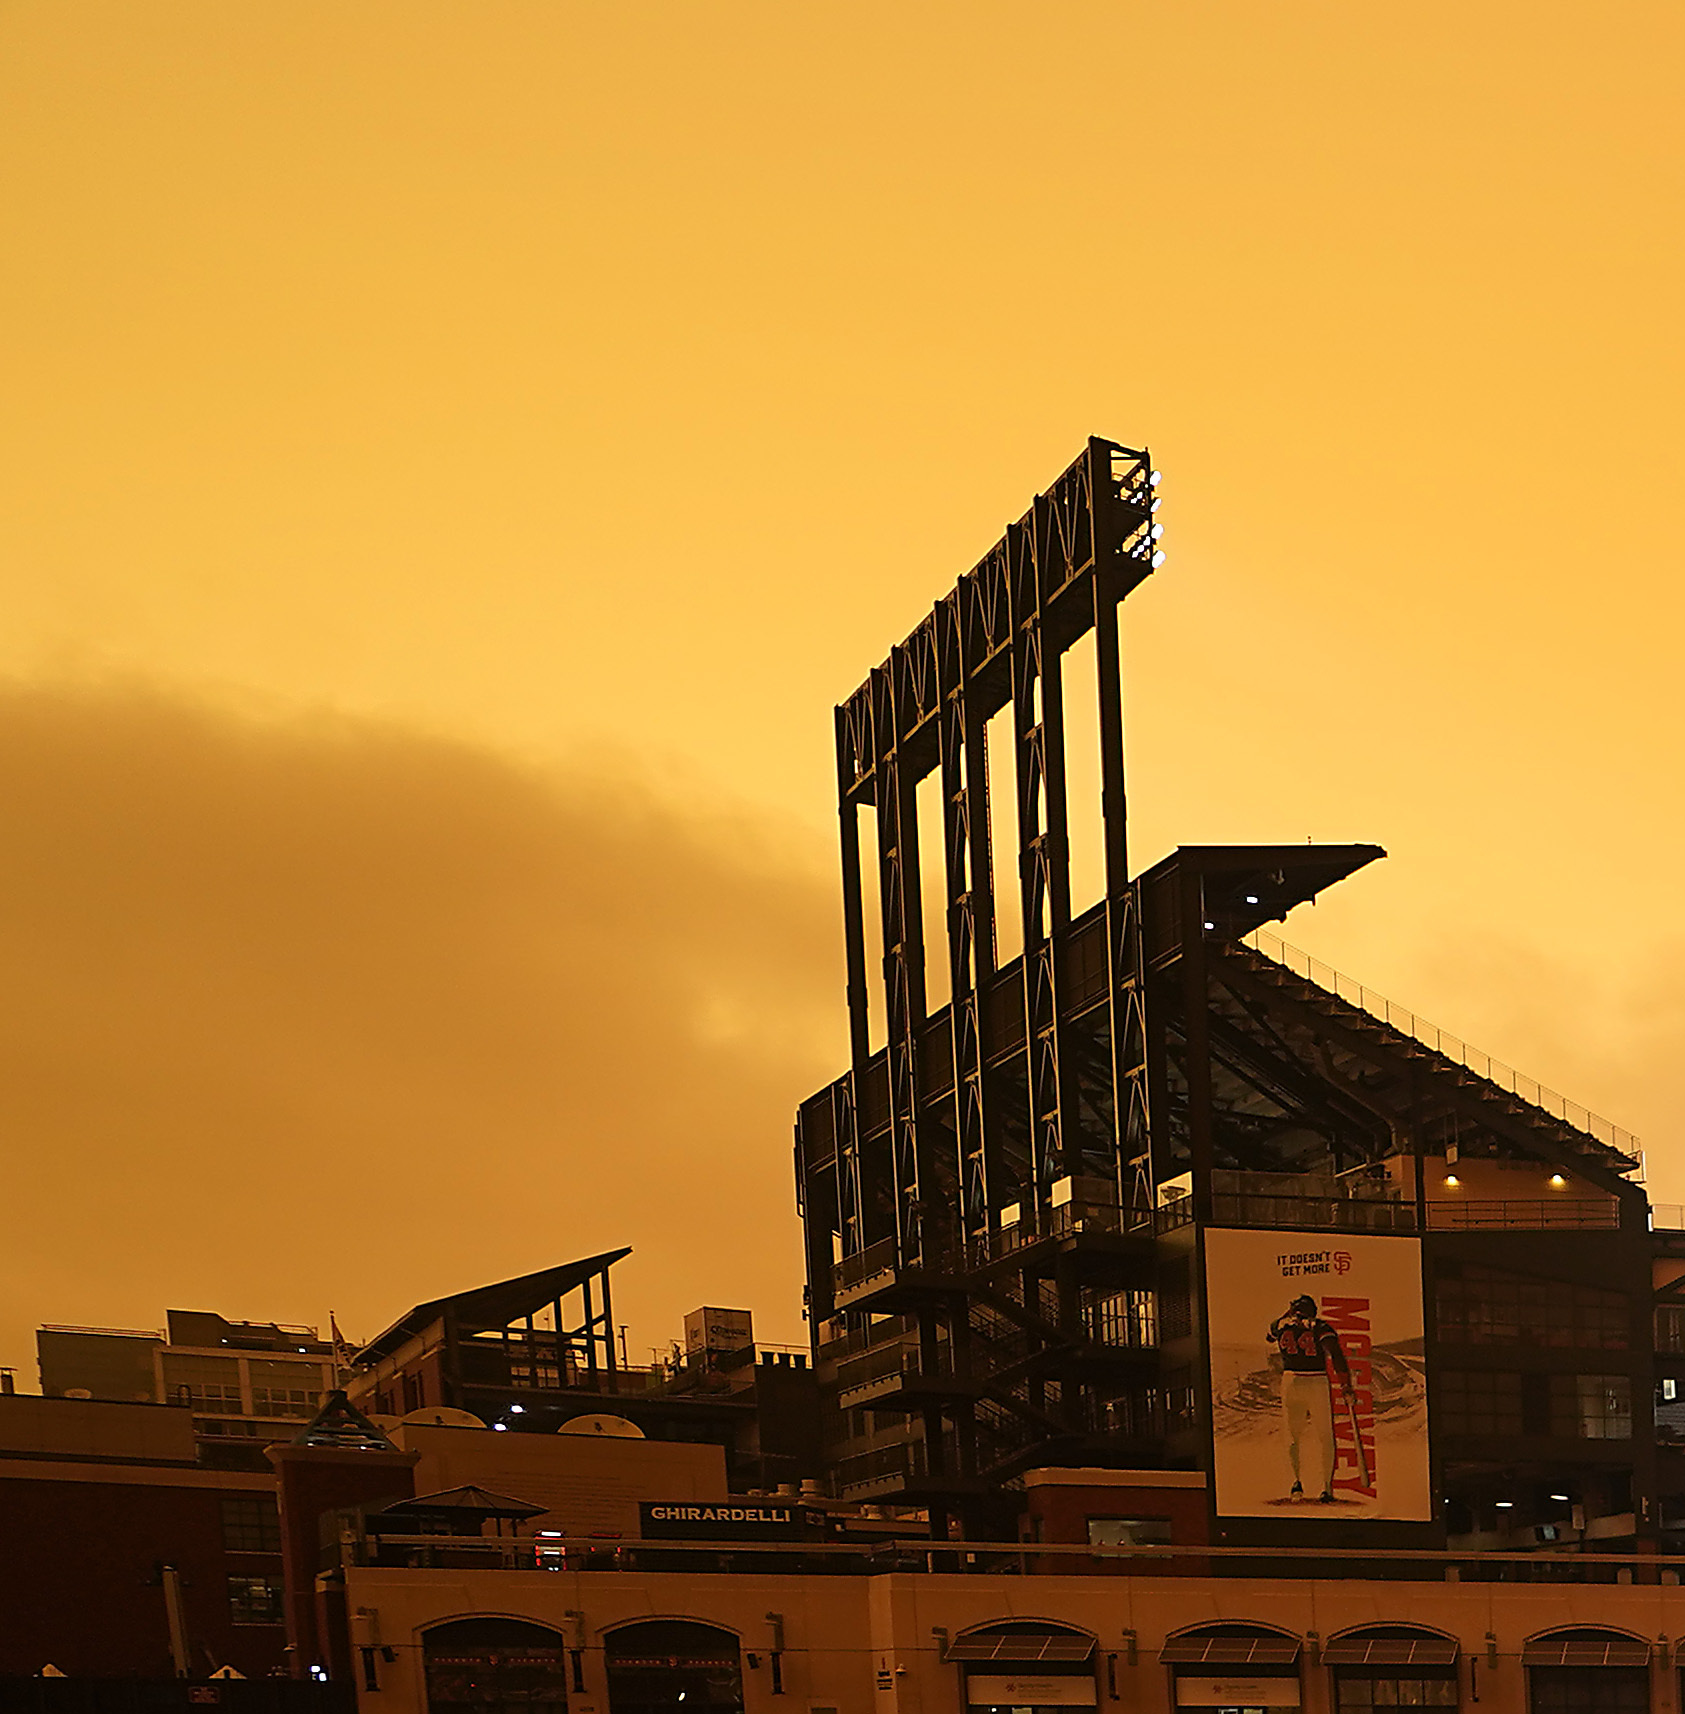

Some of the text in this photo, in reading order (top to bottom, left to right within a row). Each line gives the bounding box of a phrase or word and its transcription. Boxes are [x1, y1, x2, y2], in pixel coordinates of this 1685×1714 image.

[1277, 1251, 1331, 1266] IT DOESN'T
[1282, 1263, 1330, 1277] GET MORE
[651, 1507, 791, 1523] GHIRARDELLI
